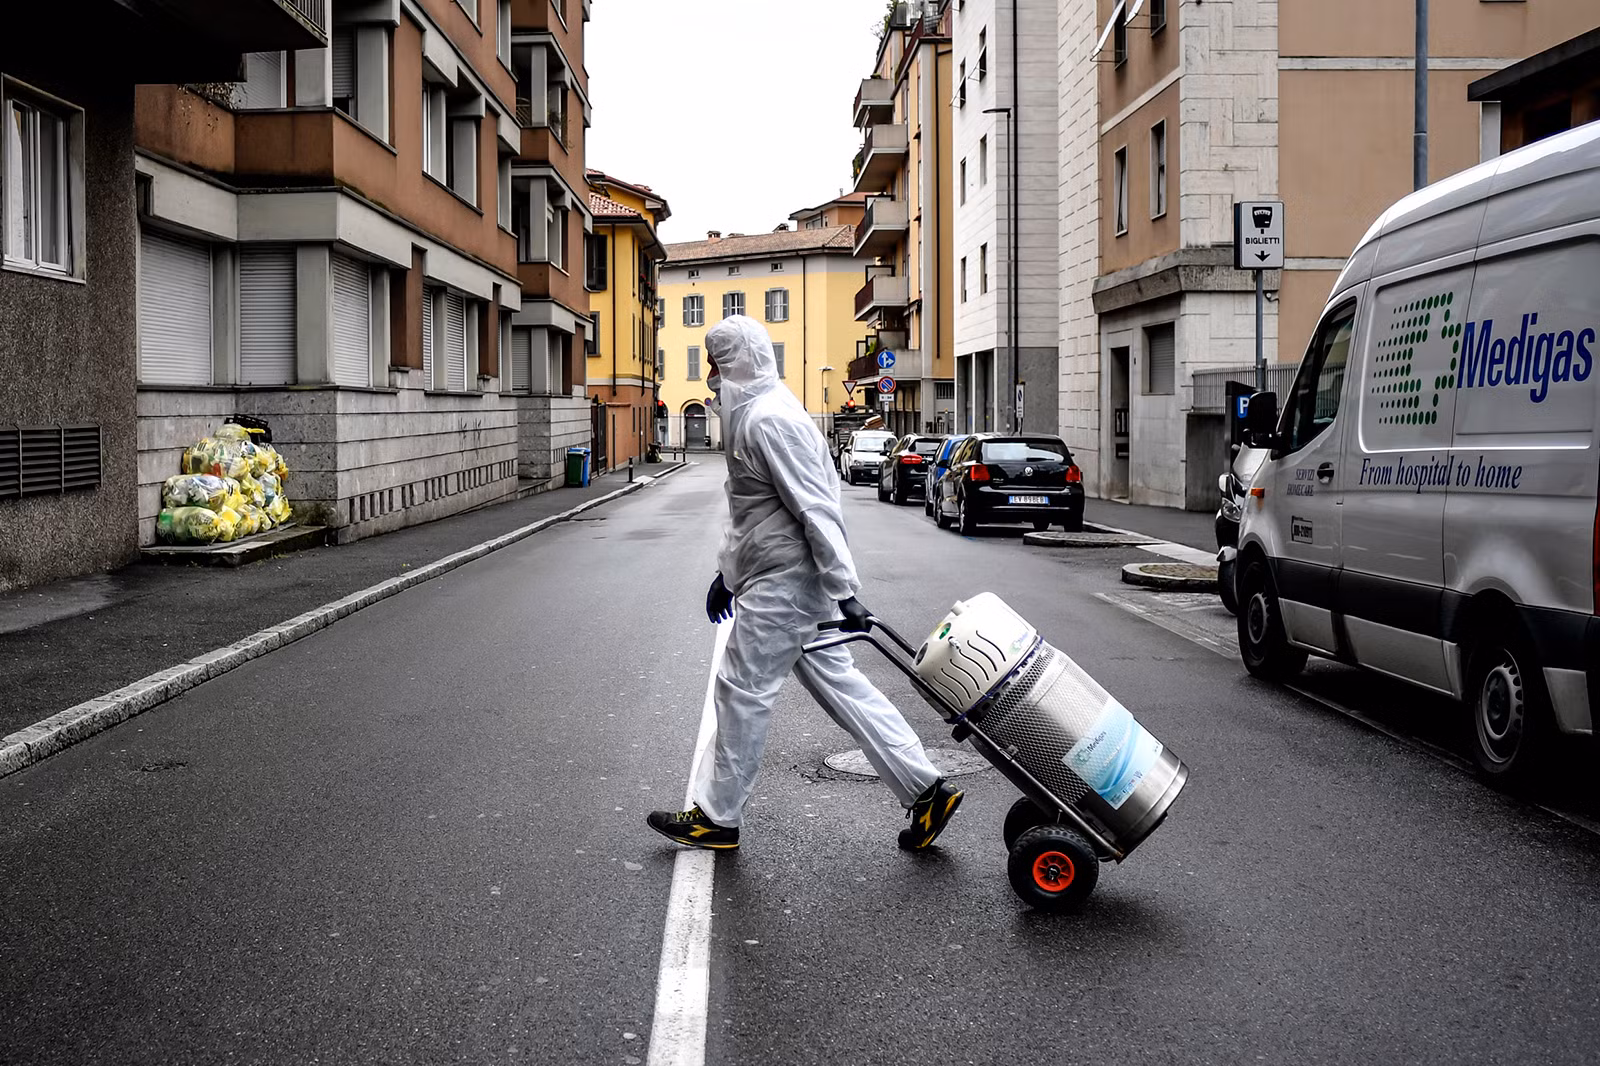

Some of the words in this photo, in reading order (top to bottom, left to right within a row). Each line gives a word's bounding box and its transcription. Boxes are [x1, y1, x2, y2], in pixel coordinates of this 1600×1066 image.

[1245, 237, 1280, 245] BIGLIETTI
[1457, 312, 1596, 404] Medigas
[1239, 397, 1250, 414] P
[1359, 457, 1392, 486] From
[1397, 455, 1454, 494] hospital
[1455, 459, 1471, 487] to
[1474, 455, 1523, 489] home
[1286, 483, 1314, 496] HOMECARE
[1086, 731, 1107, 753] Medigas
